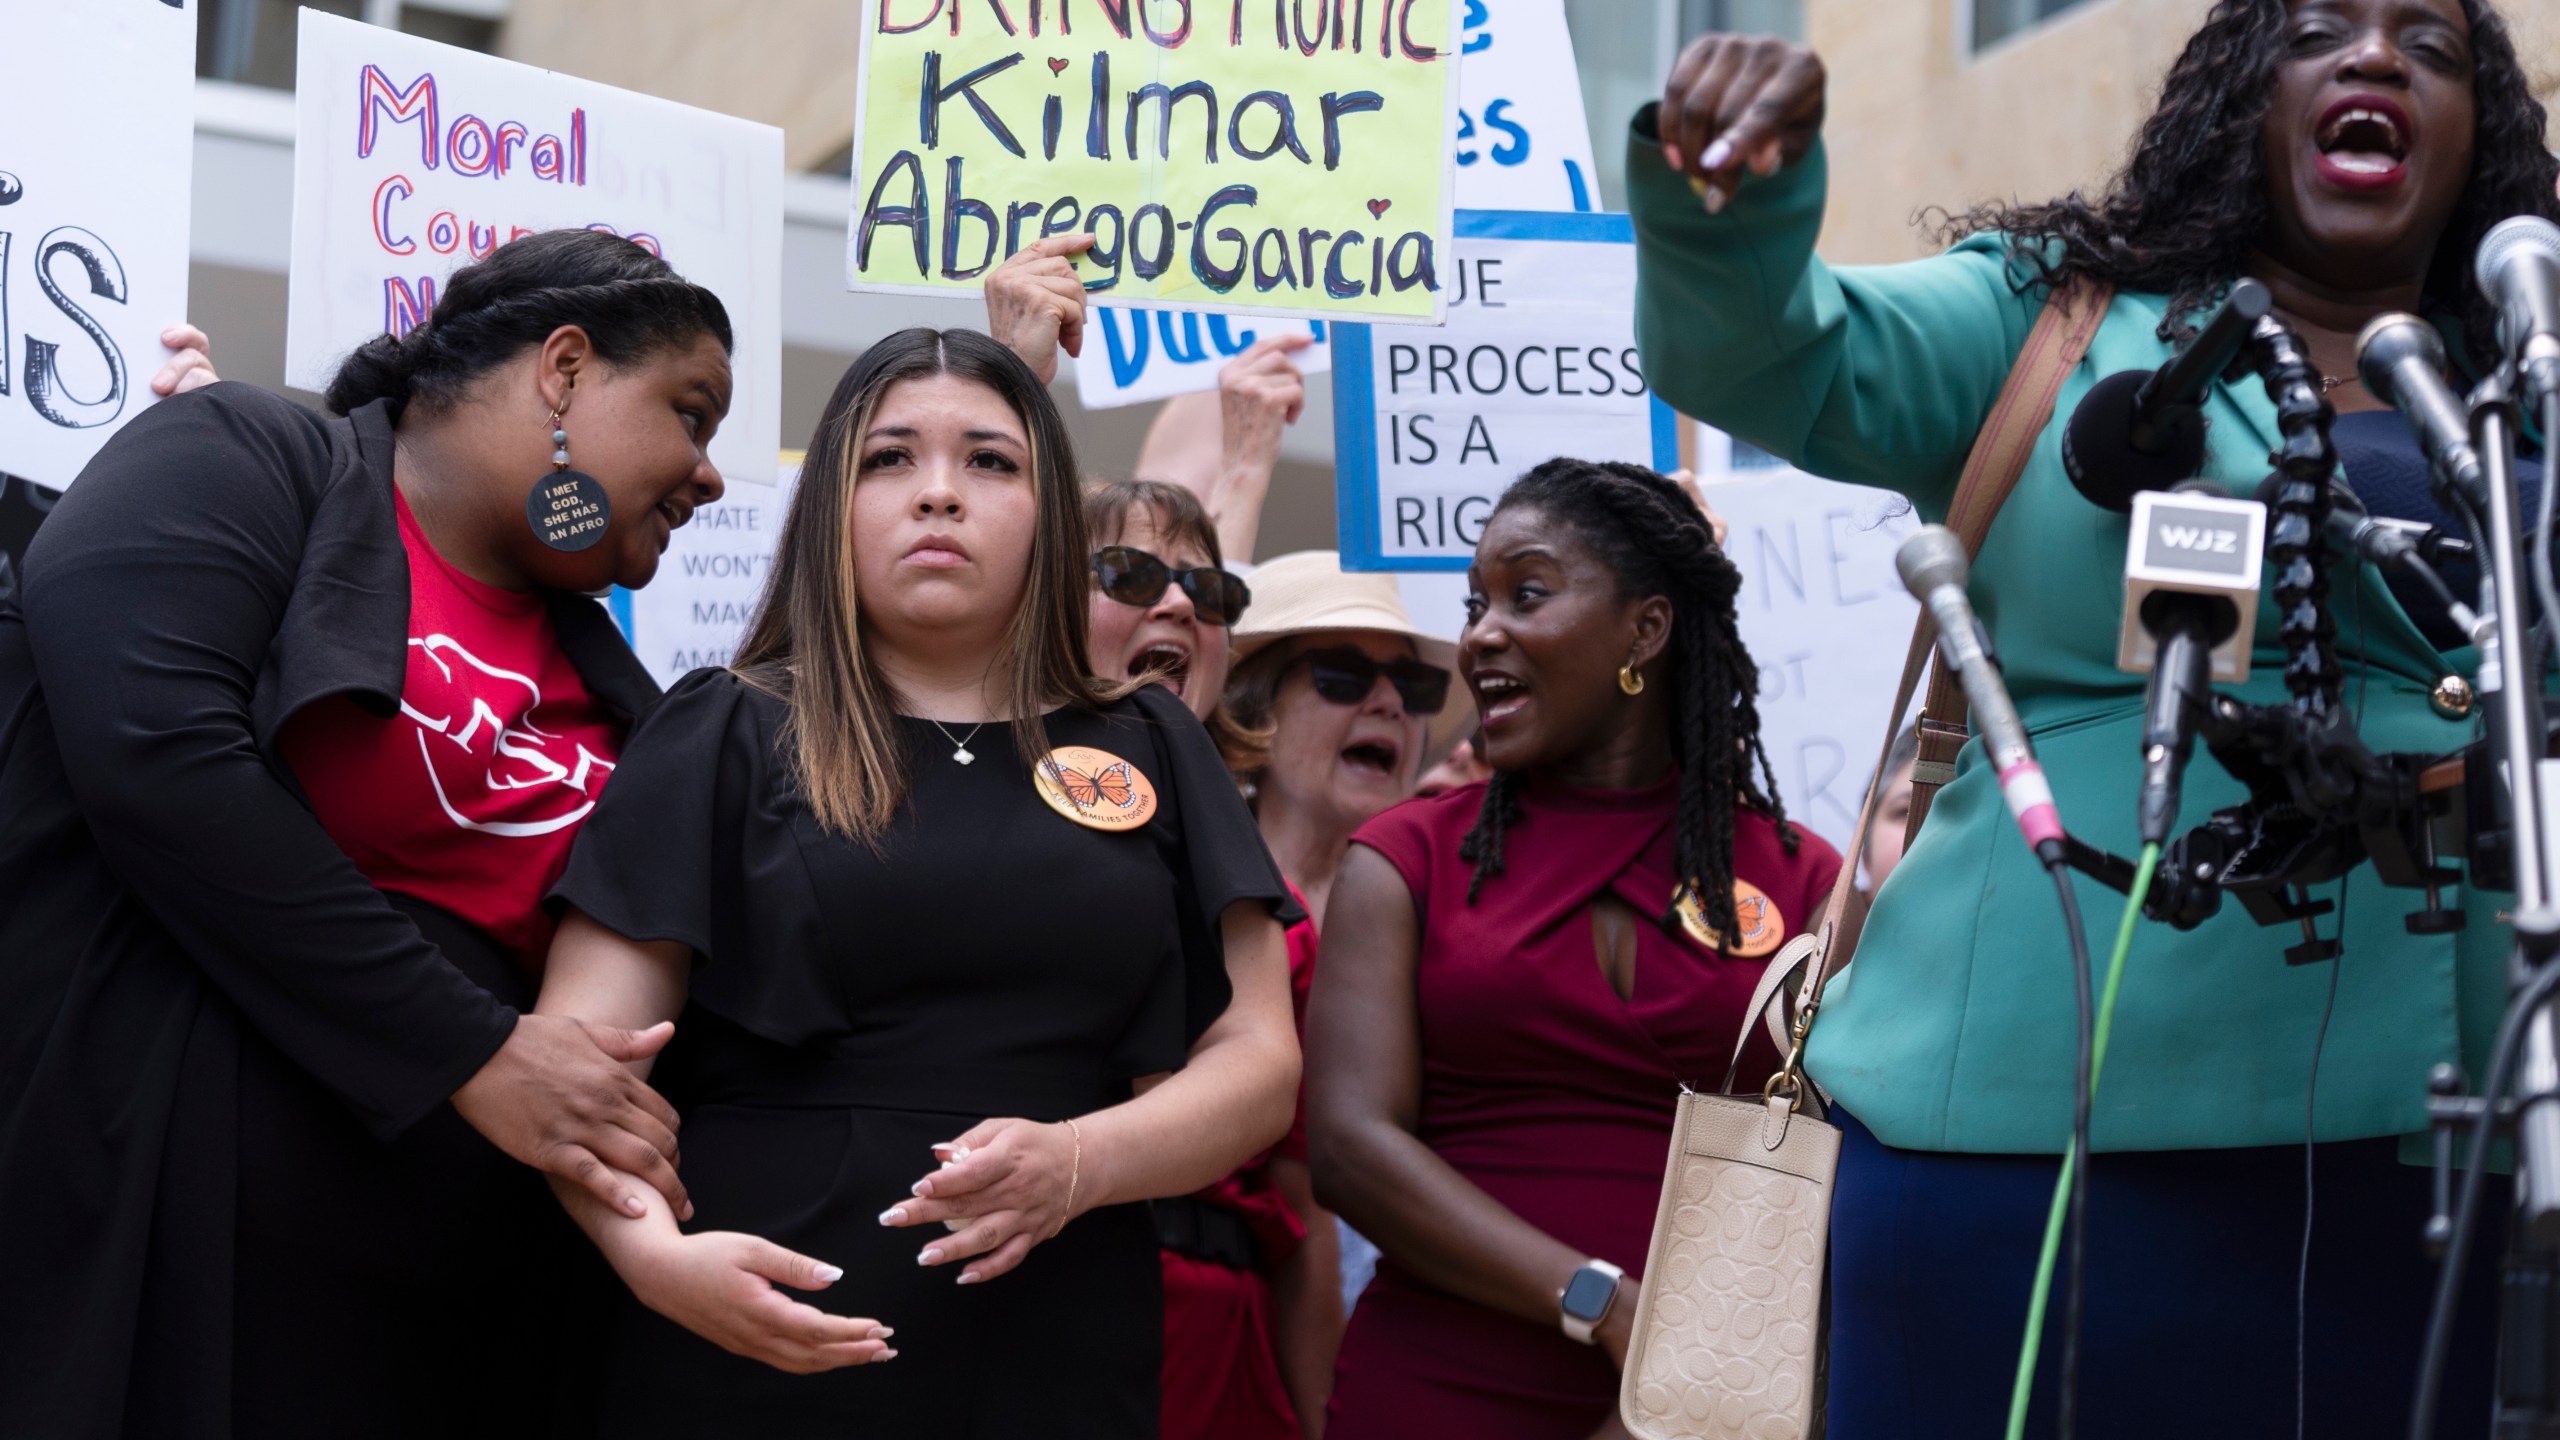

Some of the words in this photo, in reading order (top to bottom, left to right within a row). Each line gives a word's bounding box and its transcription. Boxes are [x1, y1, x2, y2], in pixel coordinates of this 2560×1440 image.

[357, 63, 587, 187] Moral
[920, 49, 1384, 172] Kilmar
[857, 149, 1440, 300] Abrego-Garcia
[1389, 344, 1649, 397] PROCESS
[1392, 414, 1438, 465] IS
[1460, 414, 1500, 465] A
[545, 490, 551, 499] I
[553, 481, 579, 497] MET
[551, 495, 584, 511] GOD,
[544, 512, 570, 527] SHE
[572, 503, 599, 519] HAS
[549, 528, 568, 542] AN
[570, 517, 605, 535] AFRO
[694, 507, 760, 531] HATE
[1396, 496, 1492, 548] RIG
[2159, 523, 2238, 554] WJZ
[693, 601, 754, 625] MAK
[1122, 794, 1149, 821] TOGETHER
